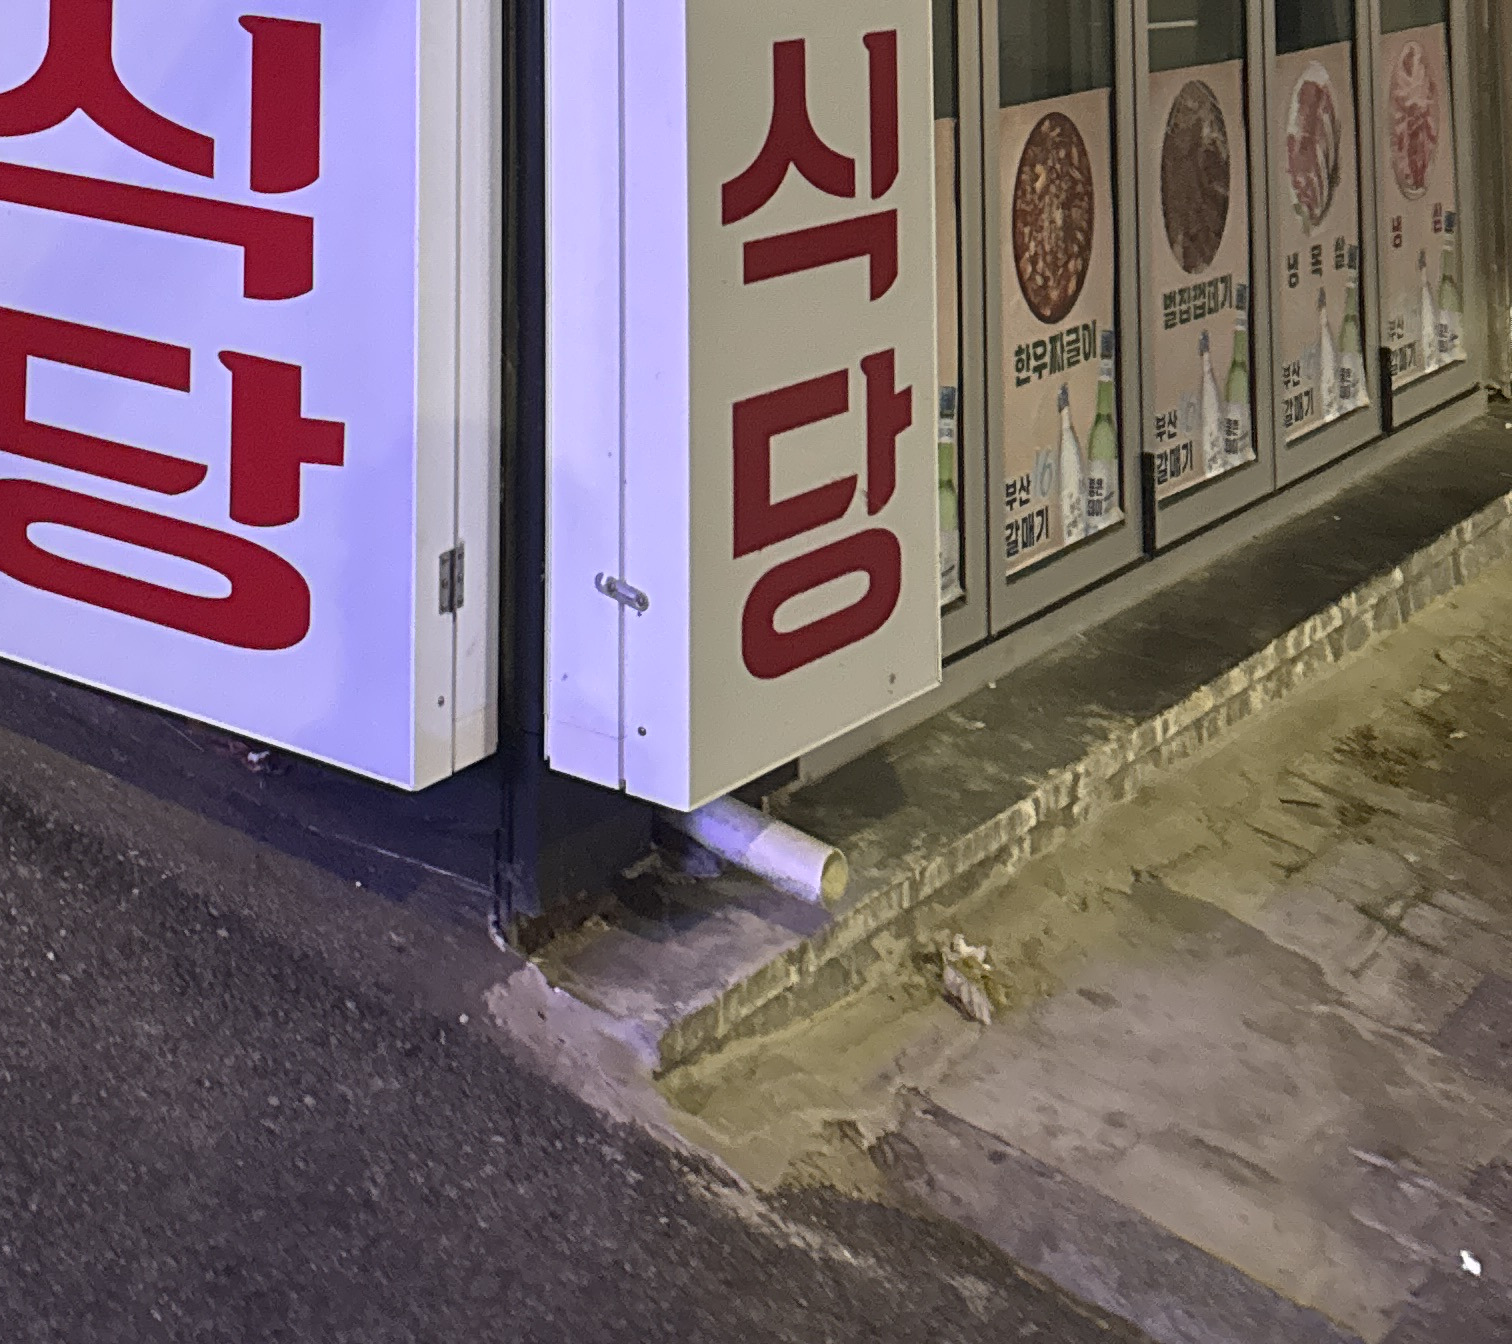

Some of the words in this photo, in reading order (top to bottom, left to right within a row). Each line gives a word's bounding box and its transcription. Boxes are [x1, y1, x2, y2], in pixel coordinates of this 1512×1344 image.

[1014, 320, 1097, 389] 한우짜글이
[1155, 409, 1178, 442] 부산
[1005, 473, 1031, 512] 부산
[1004, 505, 1050, 558] 갈매기
